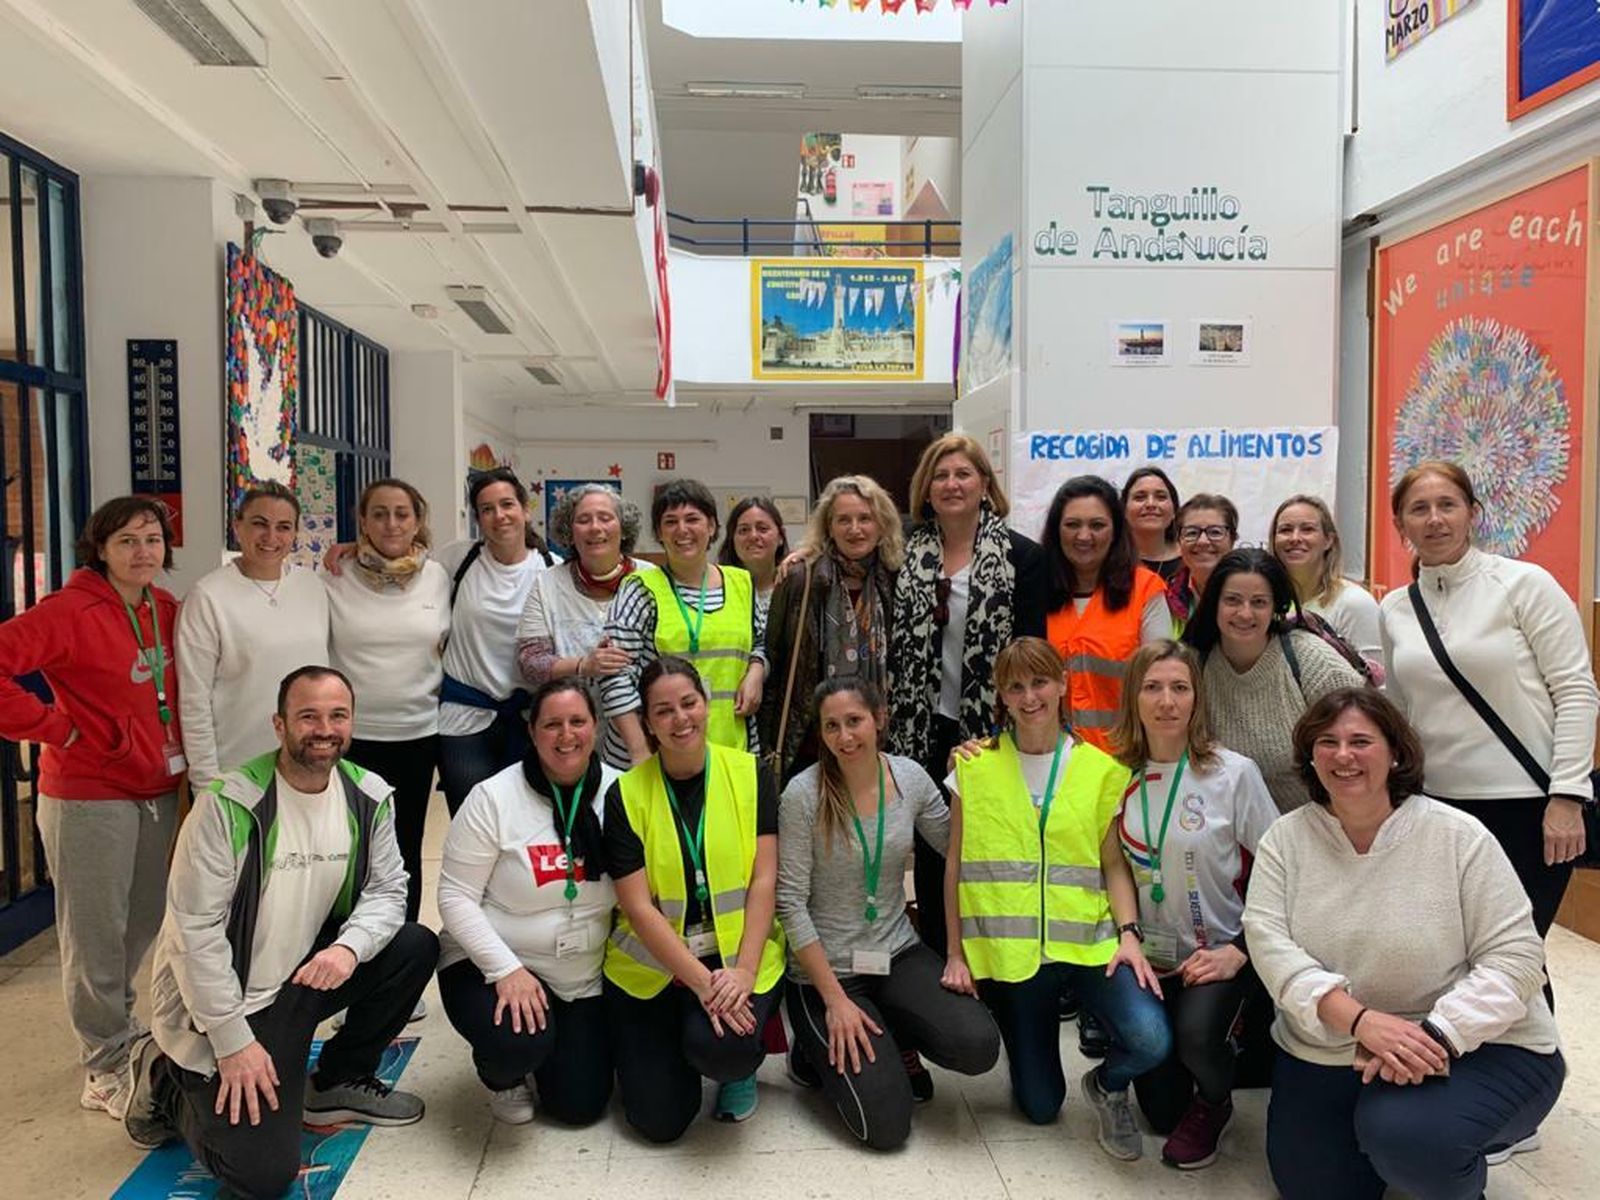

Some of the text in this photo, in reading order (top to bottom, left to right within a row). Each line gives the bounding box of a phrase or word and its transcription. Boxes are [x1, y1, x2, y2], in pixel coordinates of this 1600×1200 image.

[1385, 2, 1428, 54] MARZO
[1086, 186, 1240, 227] Tanguillo
[1034, 221, 1078, 255] de
[1384, 209, 1584, 317] We are each
[1030, 433, 1130, 460] RECOGIDA
[1147, 434, 1178, 459] DE
